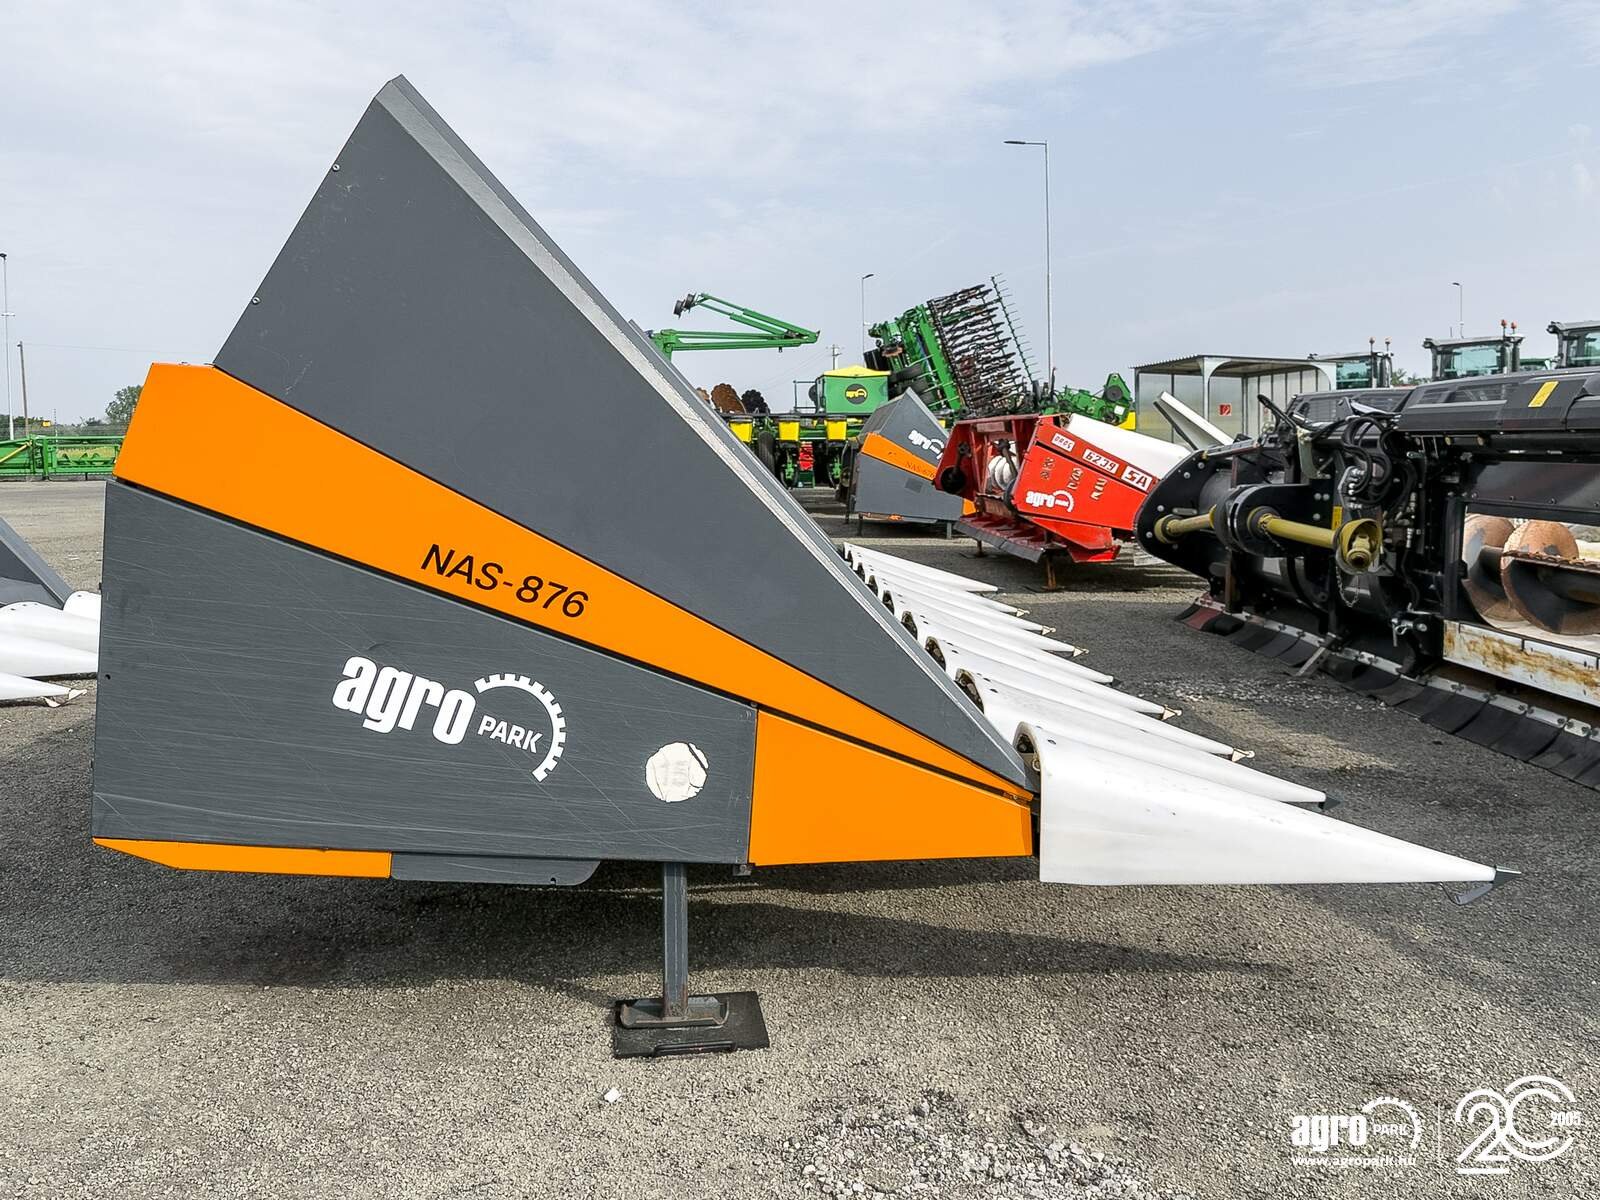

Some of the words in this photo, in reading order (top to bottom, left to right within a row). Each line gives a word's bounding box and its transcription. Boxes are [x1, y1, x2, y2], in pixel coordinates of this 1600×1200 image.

[1026, 490, 1056, 509] agro
[420, 543, 589, 618] NAS-876
[332, 656, 477, 745] agro
[477, 714, 543, 754] PARK
